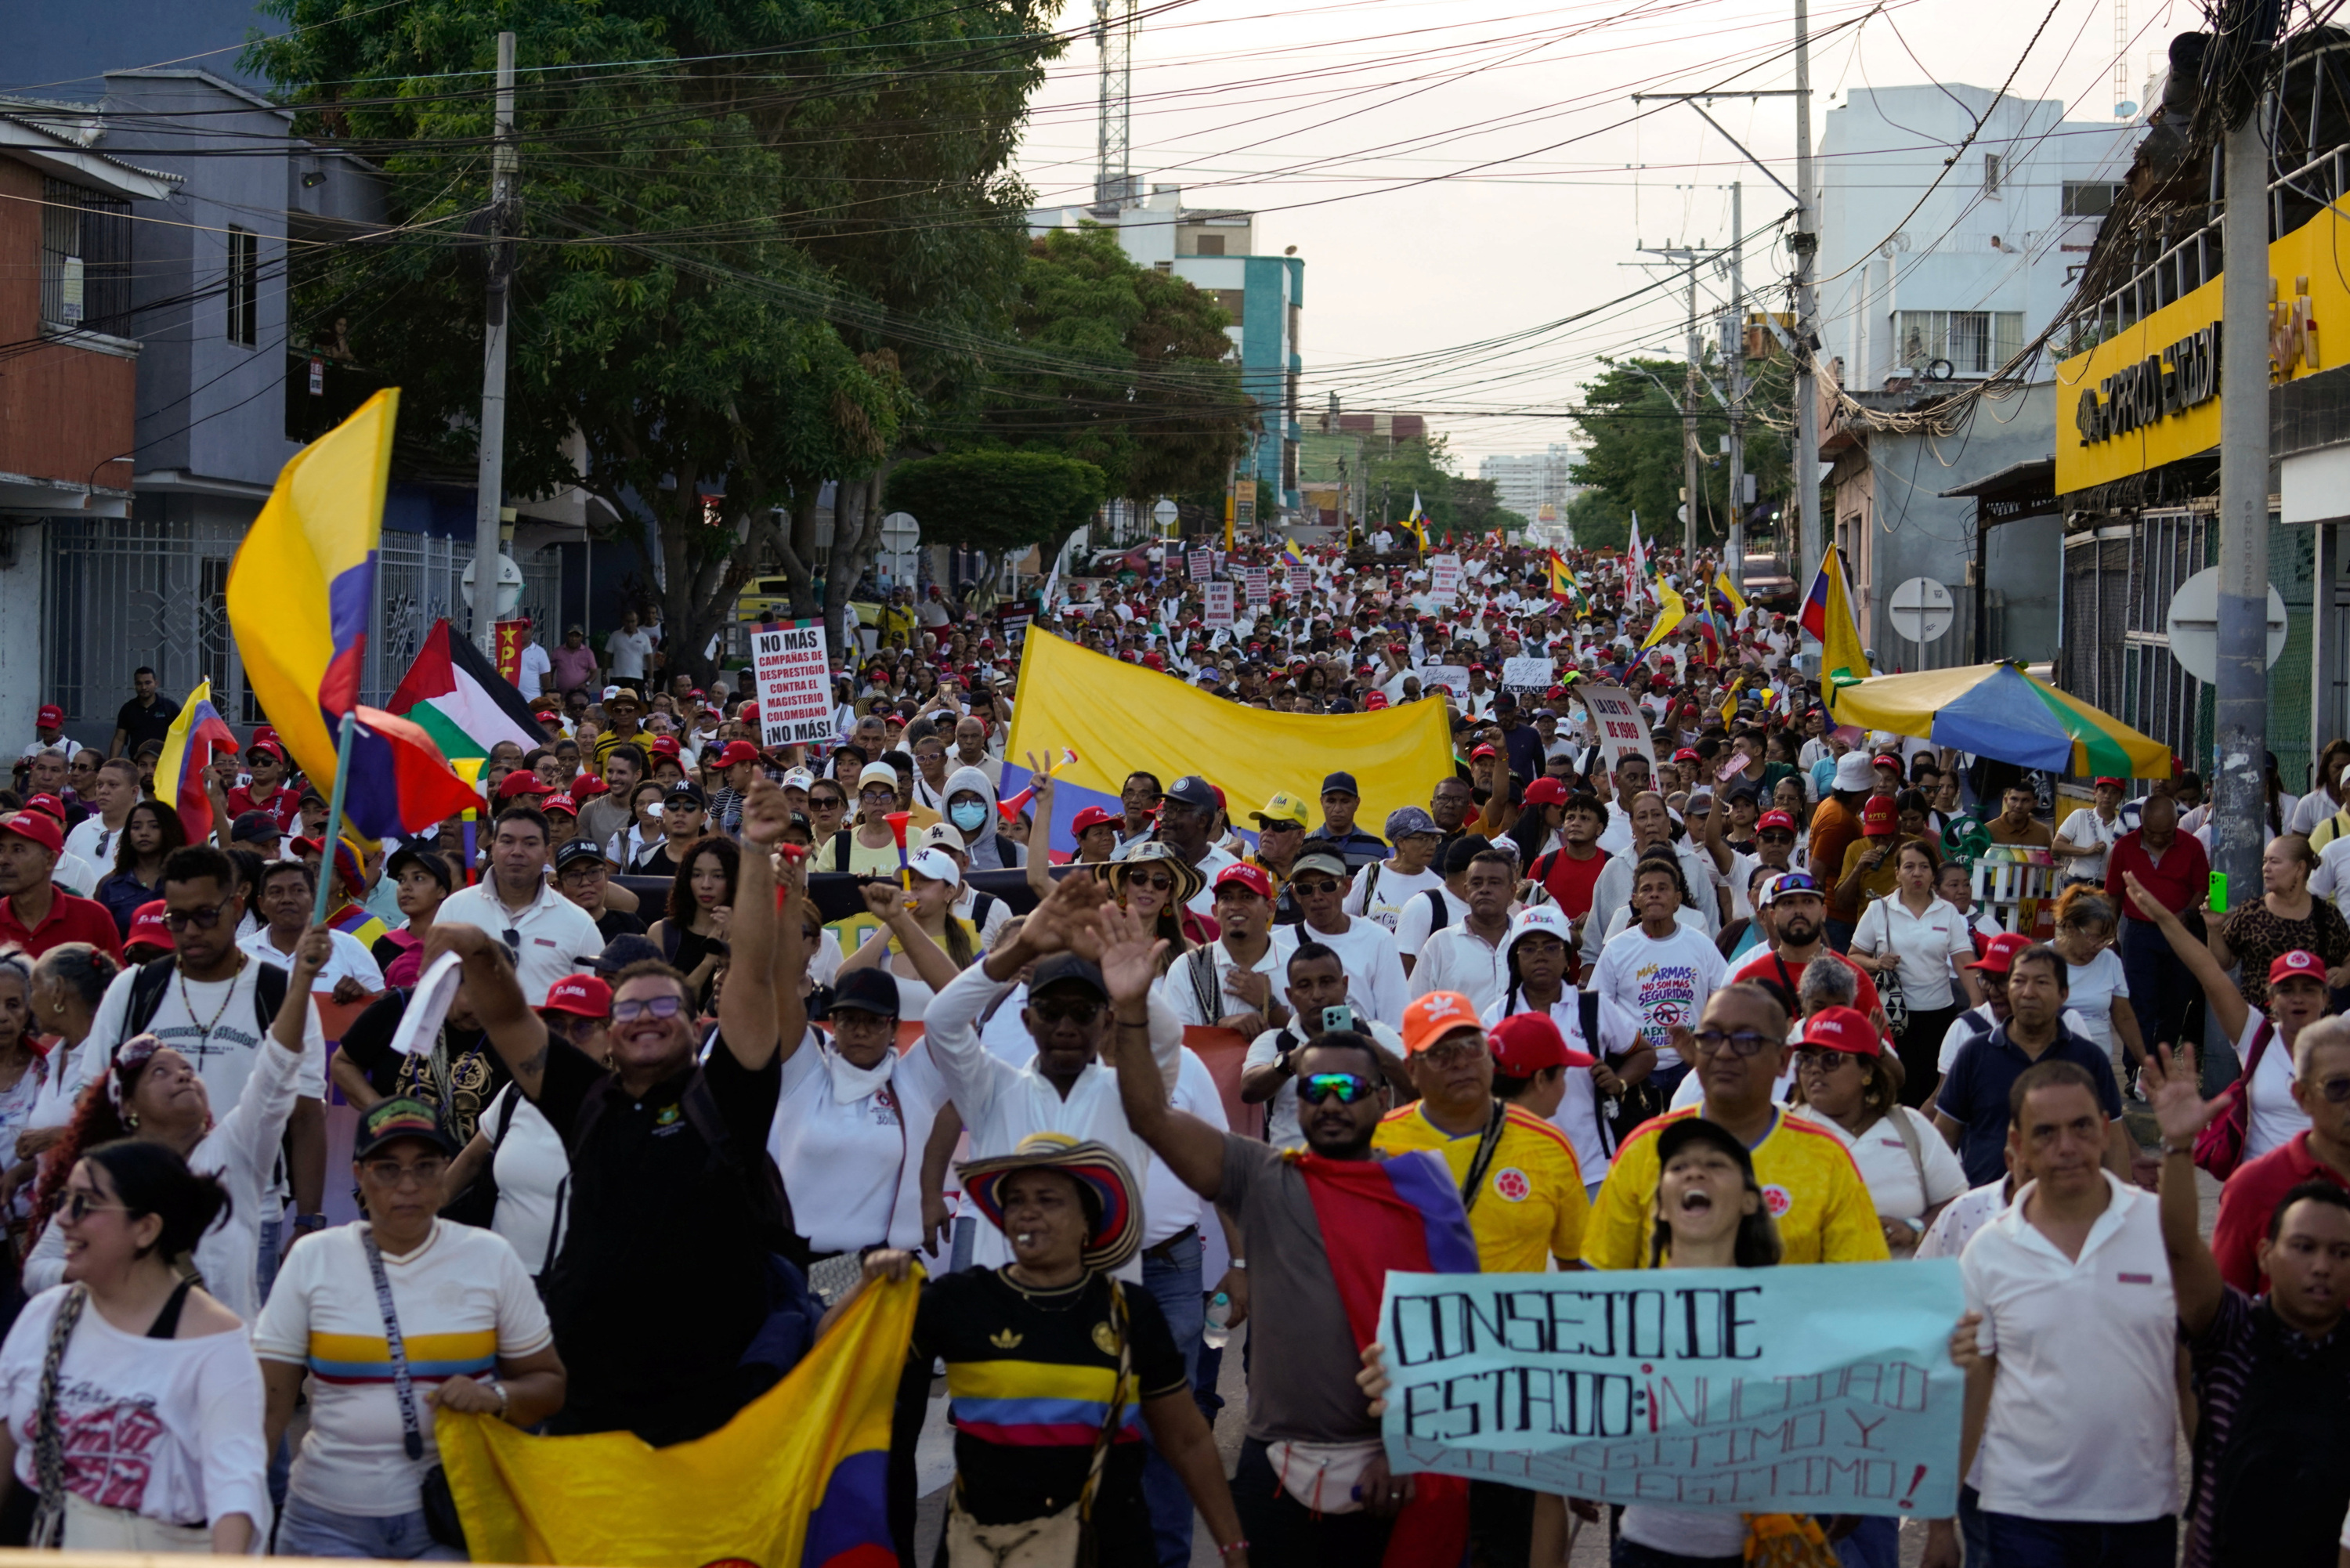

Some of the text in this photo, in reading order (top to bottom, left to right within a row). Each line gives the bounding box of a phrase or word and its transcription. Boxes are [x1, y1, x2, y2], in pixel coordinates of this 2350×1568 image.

[760, 628, 817, 653] NO MÁS
[759, 651, 823, 667] CAMPAÑAS DE
[760, 664, 825, 681] DESPRESTIGIO
[770, 679, 819, 694] CONTRA EL
[767, 693, 823, 708] MAGISTERIO
[1593, 699, 1632, 716] LA LEY 91
[767, 706, 827, 722] COLOMBIANO
[766, 720, 831, 745] ¡NO MÁS!
[1606, 721, 1639, 739] DE 1989
[1636, 963, 1692, 982] MÁS ARMAS
[1642, 979, 1690, 992] NO SON MÁS
[1638, 988, 1694, 1006] SEGURIDAD.
[1392, 1285, 1762, 1367] CONSEJO DE
[1405, 1366, 1646, 1443] ESTADO:
[1844, 1407, 1888, 1454] Y
